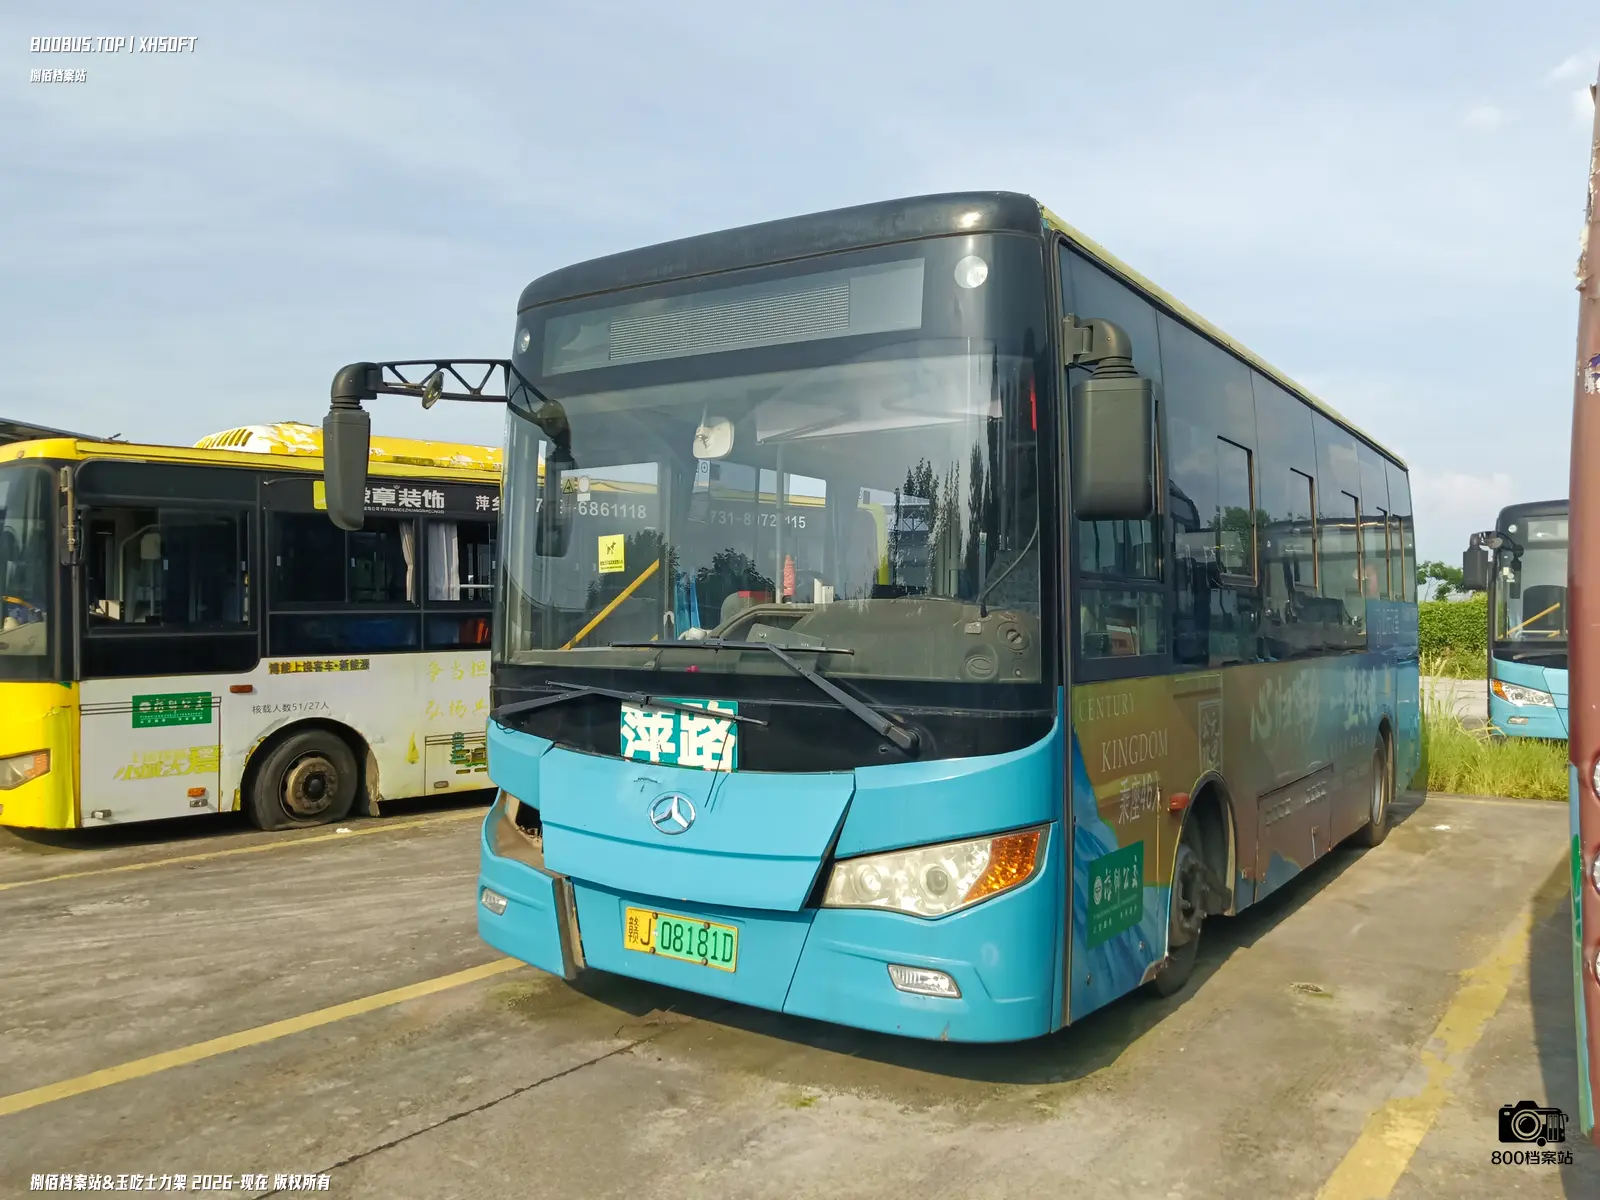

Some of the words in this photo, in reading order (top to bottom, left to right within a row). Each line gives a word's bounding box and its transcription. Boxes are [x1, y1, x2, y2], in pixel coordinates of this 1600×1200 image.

[252, 701, 330, 714] 核载人数51/27人
[1079, 692, 1135, 722] CENTURY
[1101, 728, 1169, 773] KINGDOM
[661, 921, 734, 963] 08181D
